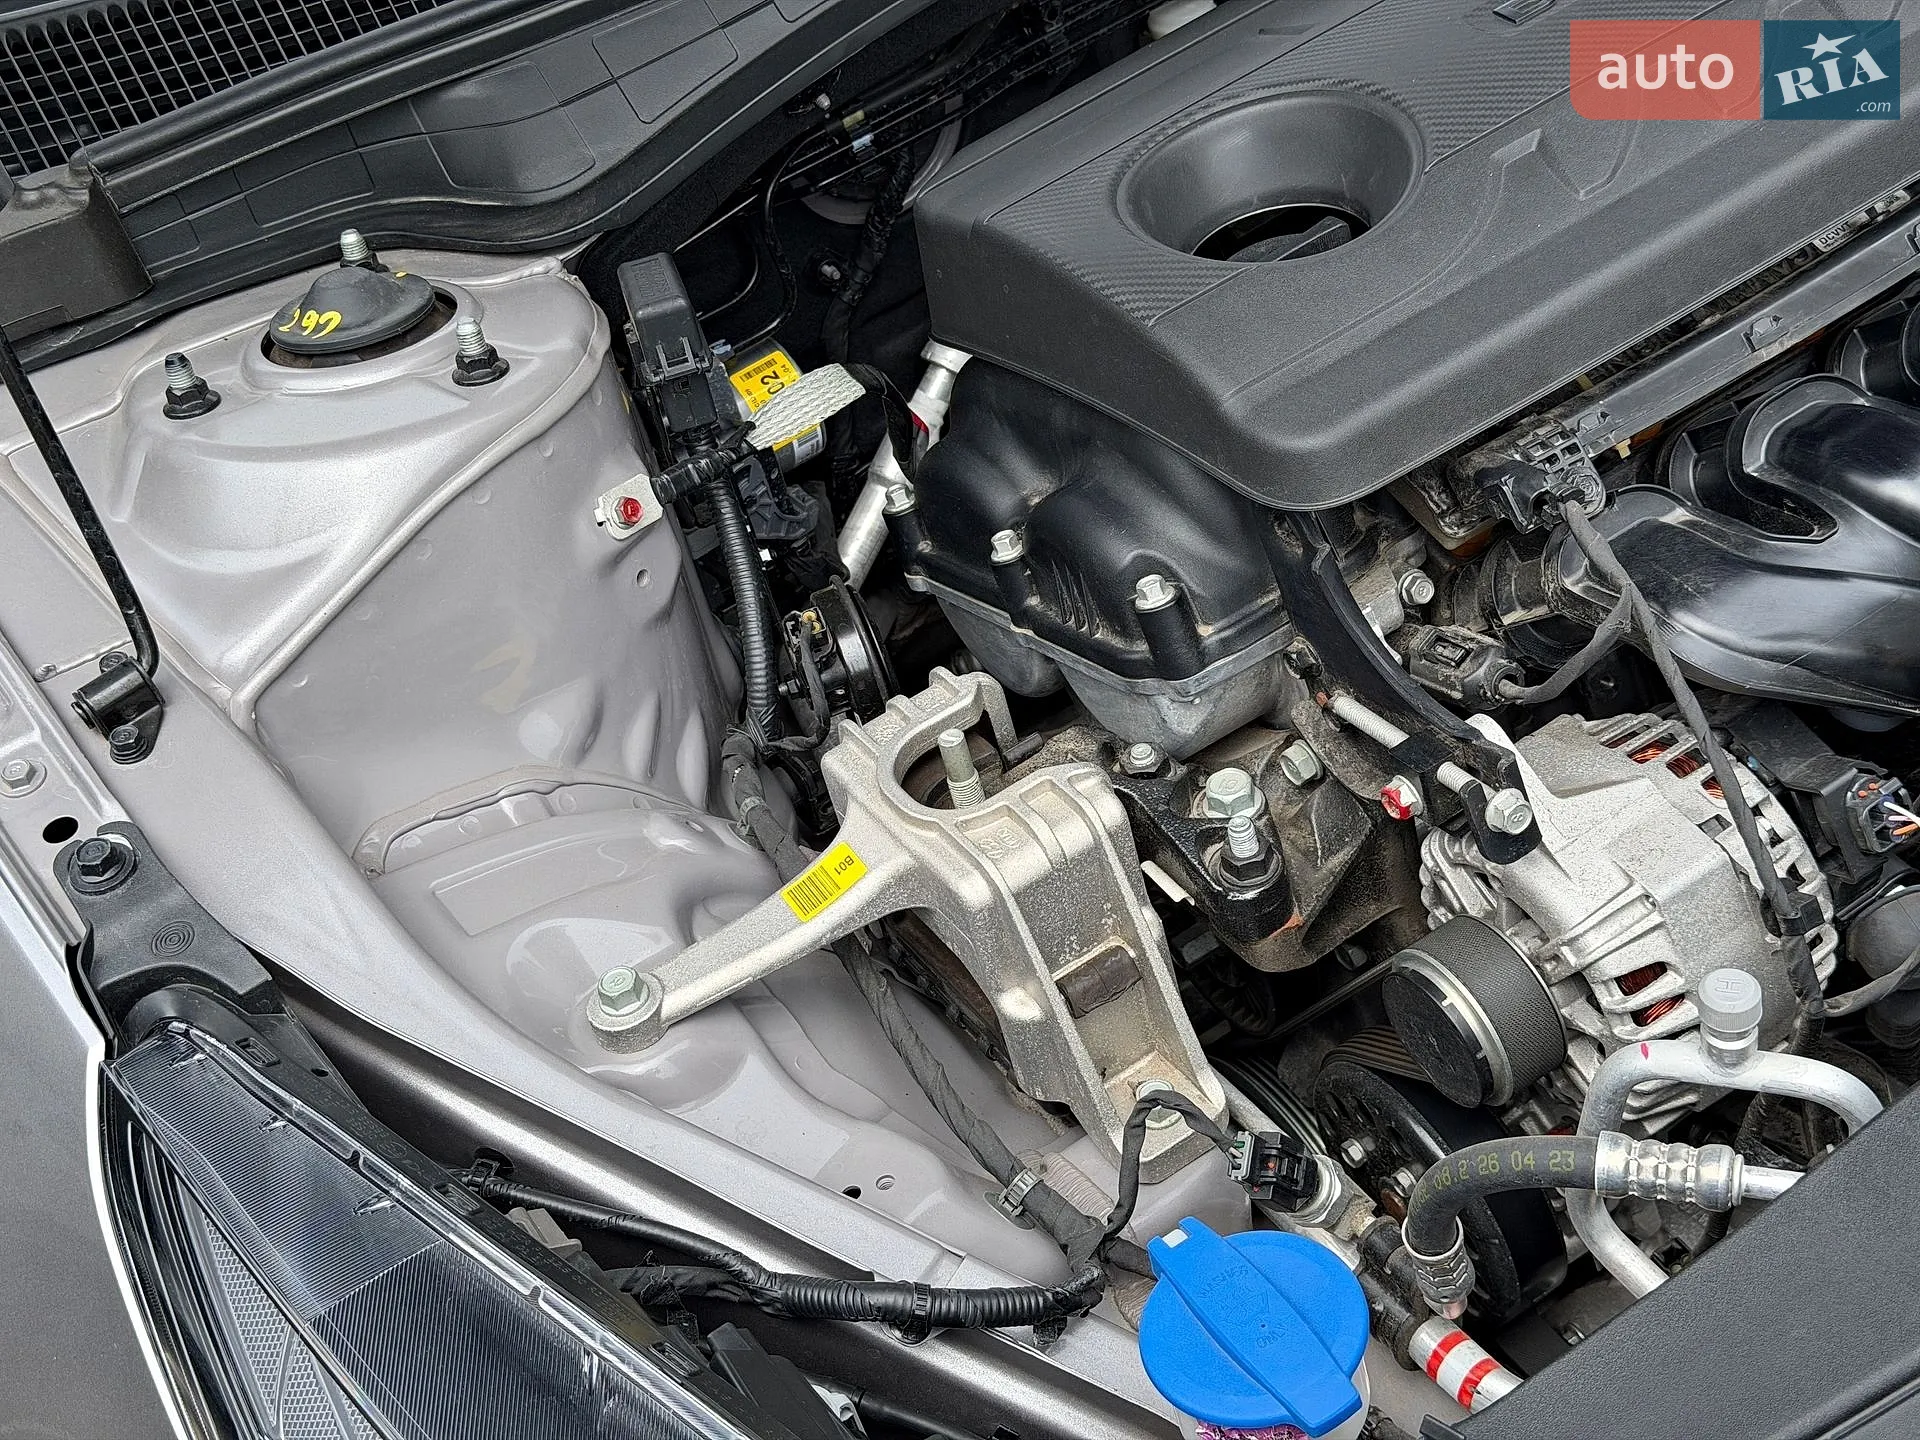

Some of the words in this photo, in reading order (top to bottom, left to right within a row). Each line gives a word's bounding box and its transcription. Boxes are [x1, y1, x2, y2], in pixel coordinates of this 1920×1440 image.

[1818, 221, 1852, 245] DCVVT
[834, 855, 855, 876] B01
[1477, 1152, 1500, 1175] 26
[1510, 1150, 1535, 1172] 04
[1549, 1149, 1575, 1172] 23
